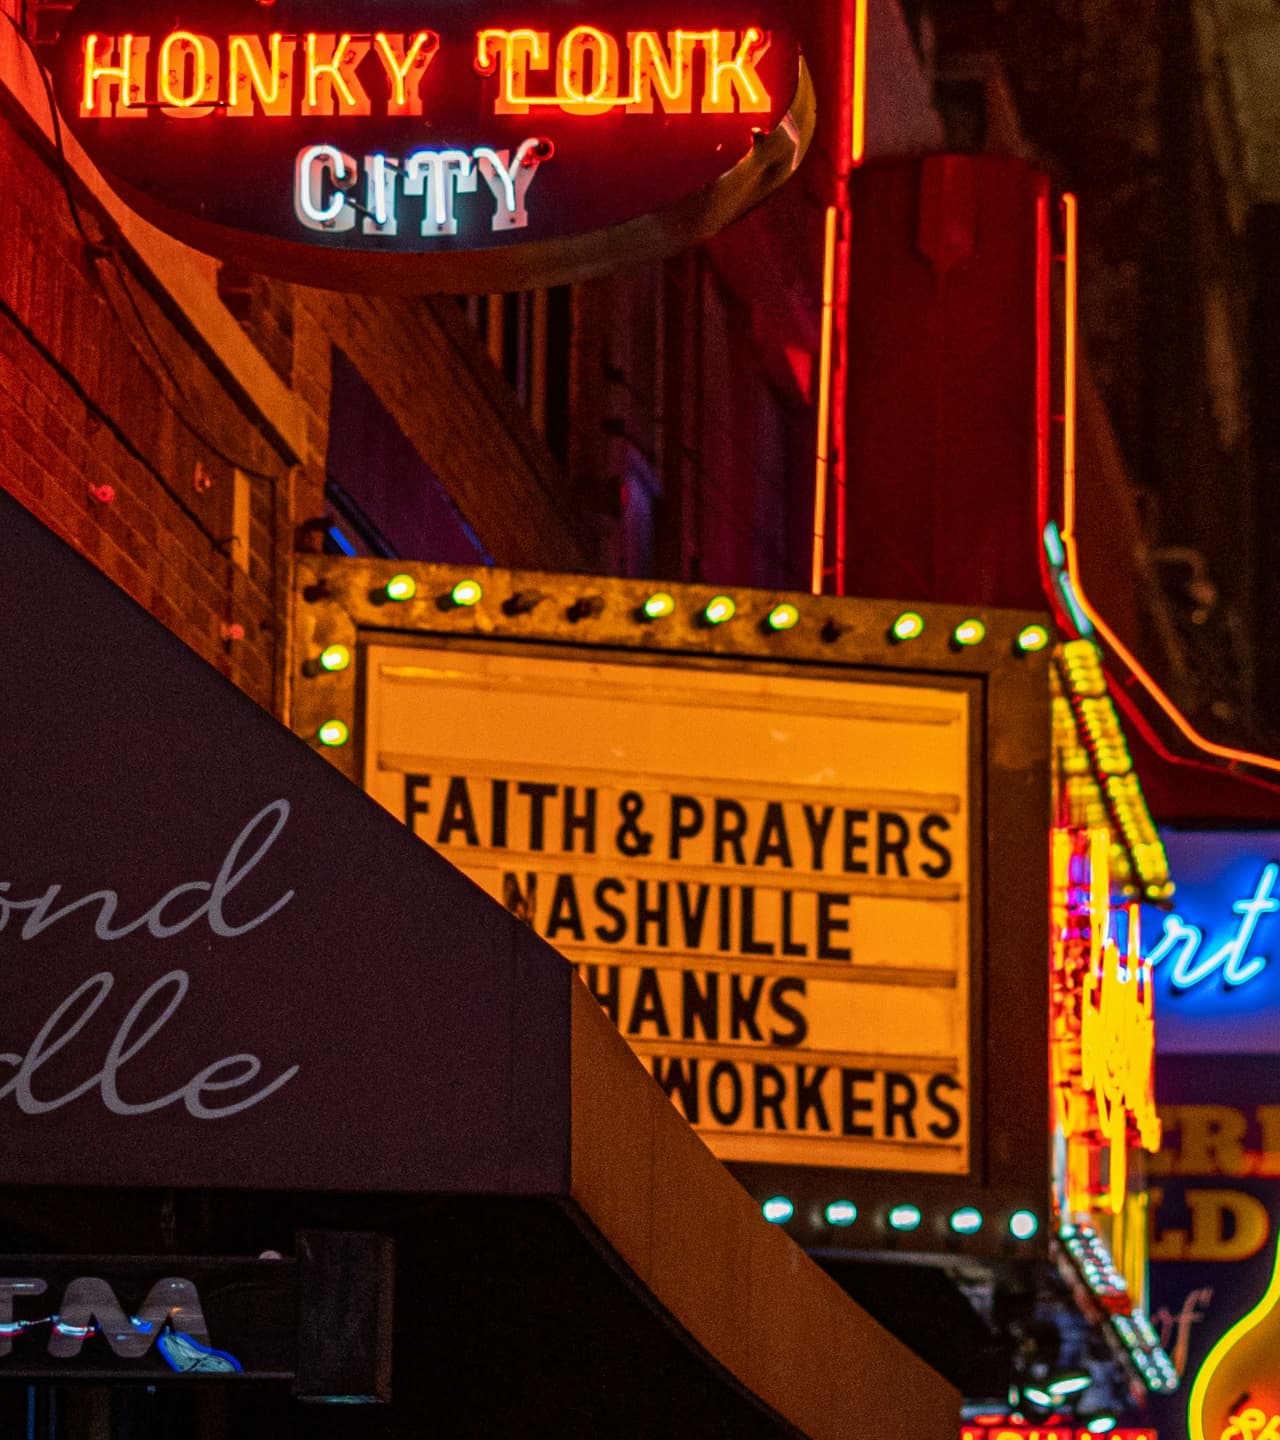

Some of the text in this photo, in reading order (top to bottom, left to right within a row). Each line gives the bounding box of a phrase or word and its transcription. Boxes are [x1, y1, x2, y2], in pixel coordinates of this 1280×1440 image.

[80, 26, 773, 118] HONKY TONK
[293, 137, 554, 237] CITY
[403, 772, 954, 880] FAITH & PRAYERS
[502, 870, 853, 962] NASHVILLE
[570, 962, 809, 1047] HANKS
[652, 1055, 964, 1140] WORKERS
